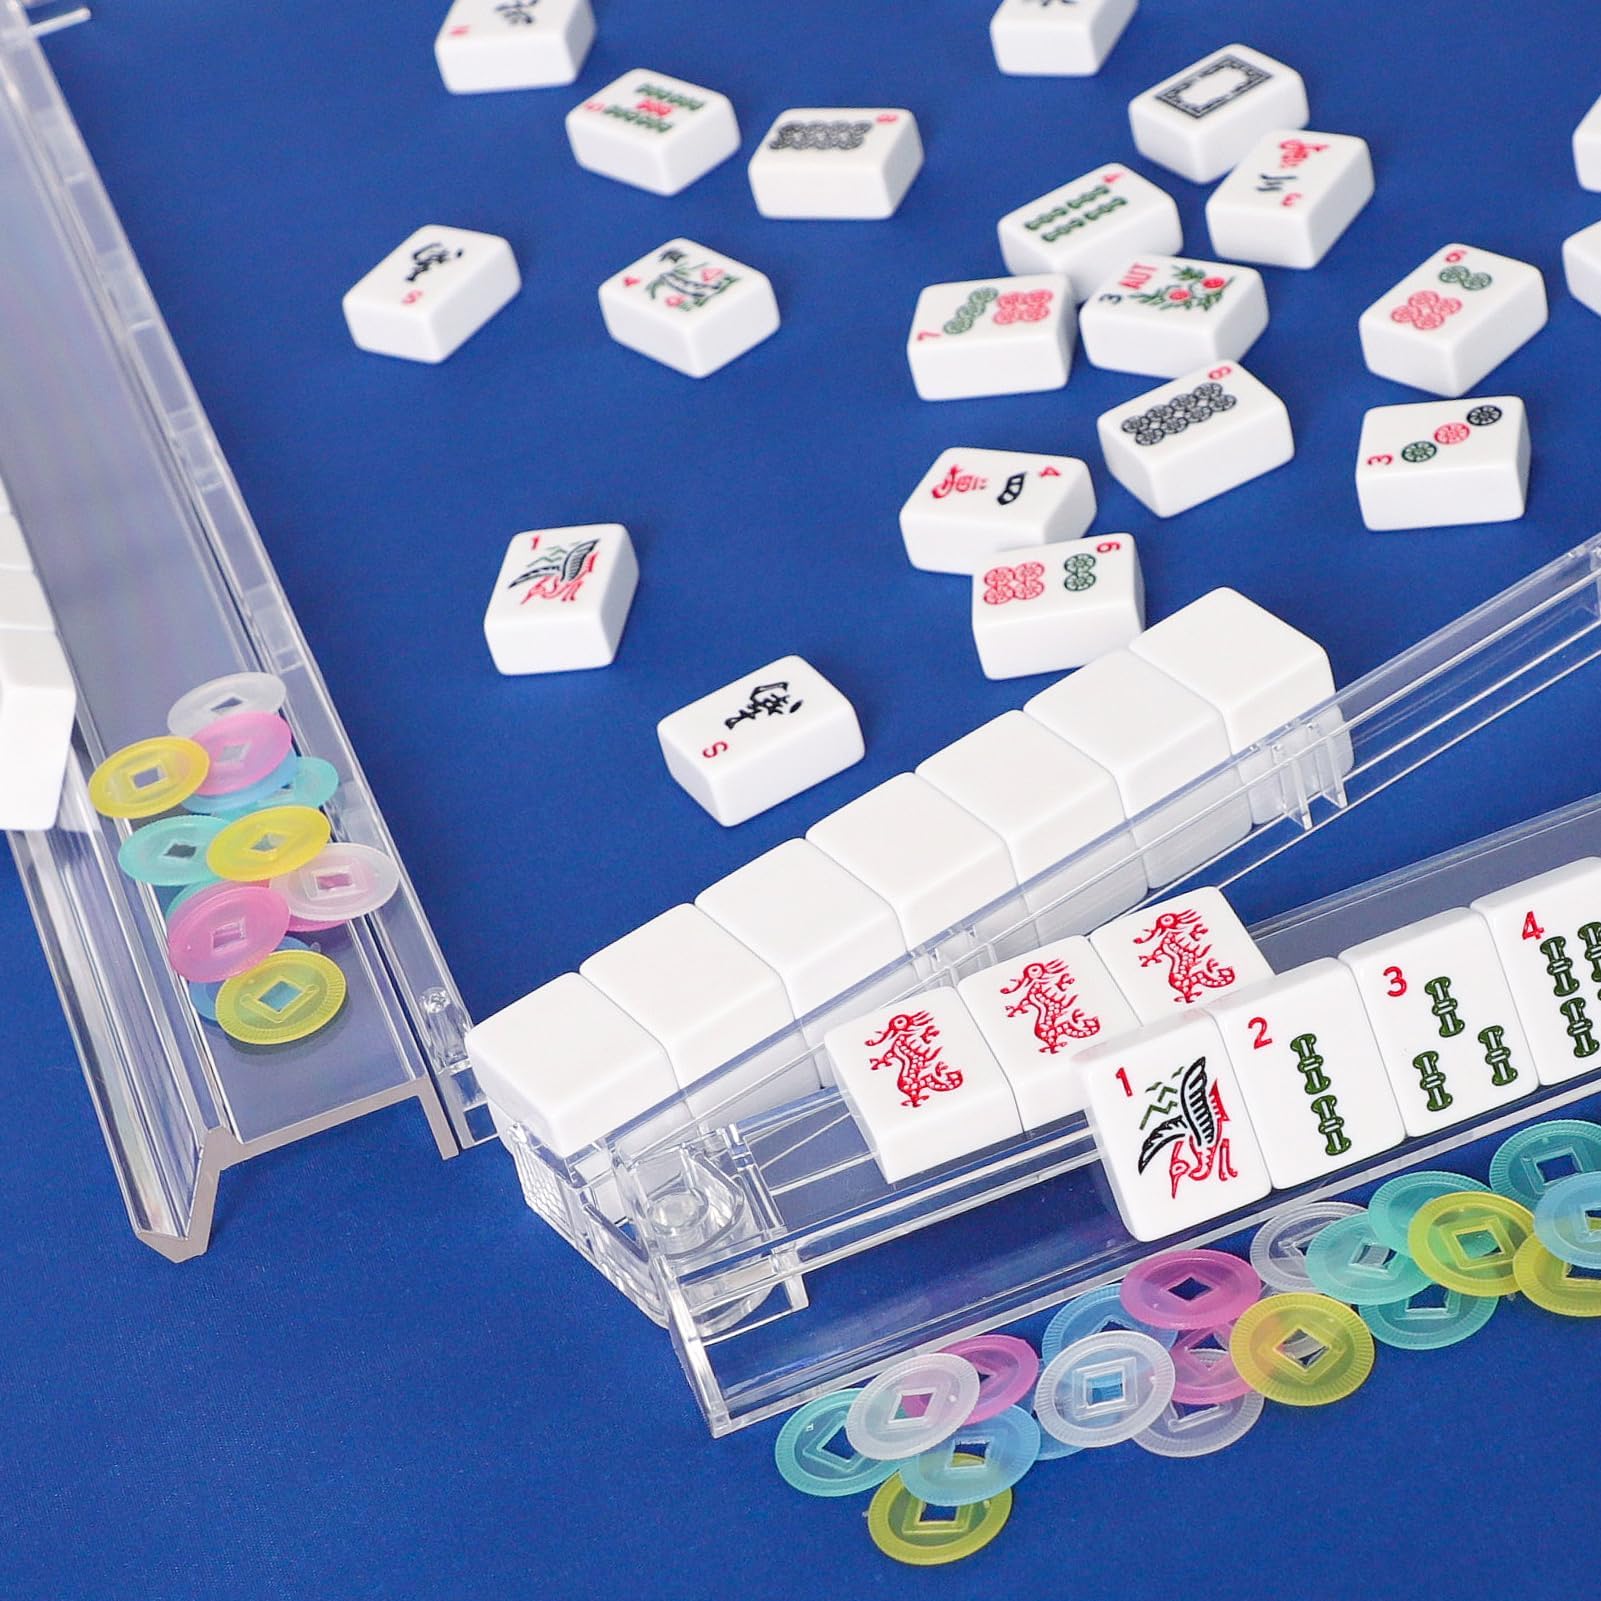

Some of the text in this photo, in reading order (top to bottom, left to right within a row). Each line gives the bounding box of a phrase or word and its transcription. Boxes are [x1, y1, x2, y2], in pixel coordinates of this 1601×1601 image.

[1443, 249, 1468, 265] 6
[1118, 262, 1160, 291] AUT
[1099, 293, 1124, 306] 3
[915, 329, 942, 343] 7
[1207, 364, 1234, 382] 8
[1365, 452, 1395, 467] 3
[1037, 464, 1063, 479] 4
[530, 534, 542, 552] 1
[1095, 540, 1123, 555] 6
[701, 739, 730, 760] S
[1519, 910, 1545, 941] 4
[1382, 965, 1409, 999] 3
[1246, 1015, 1273, 1050] 2
[1114, 1066, 1135, 1098] 1
